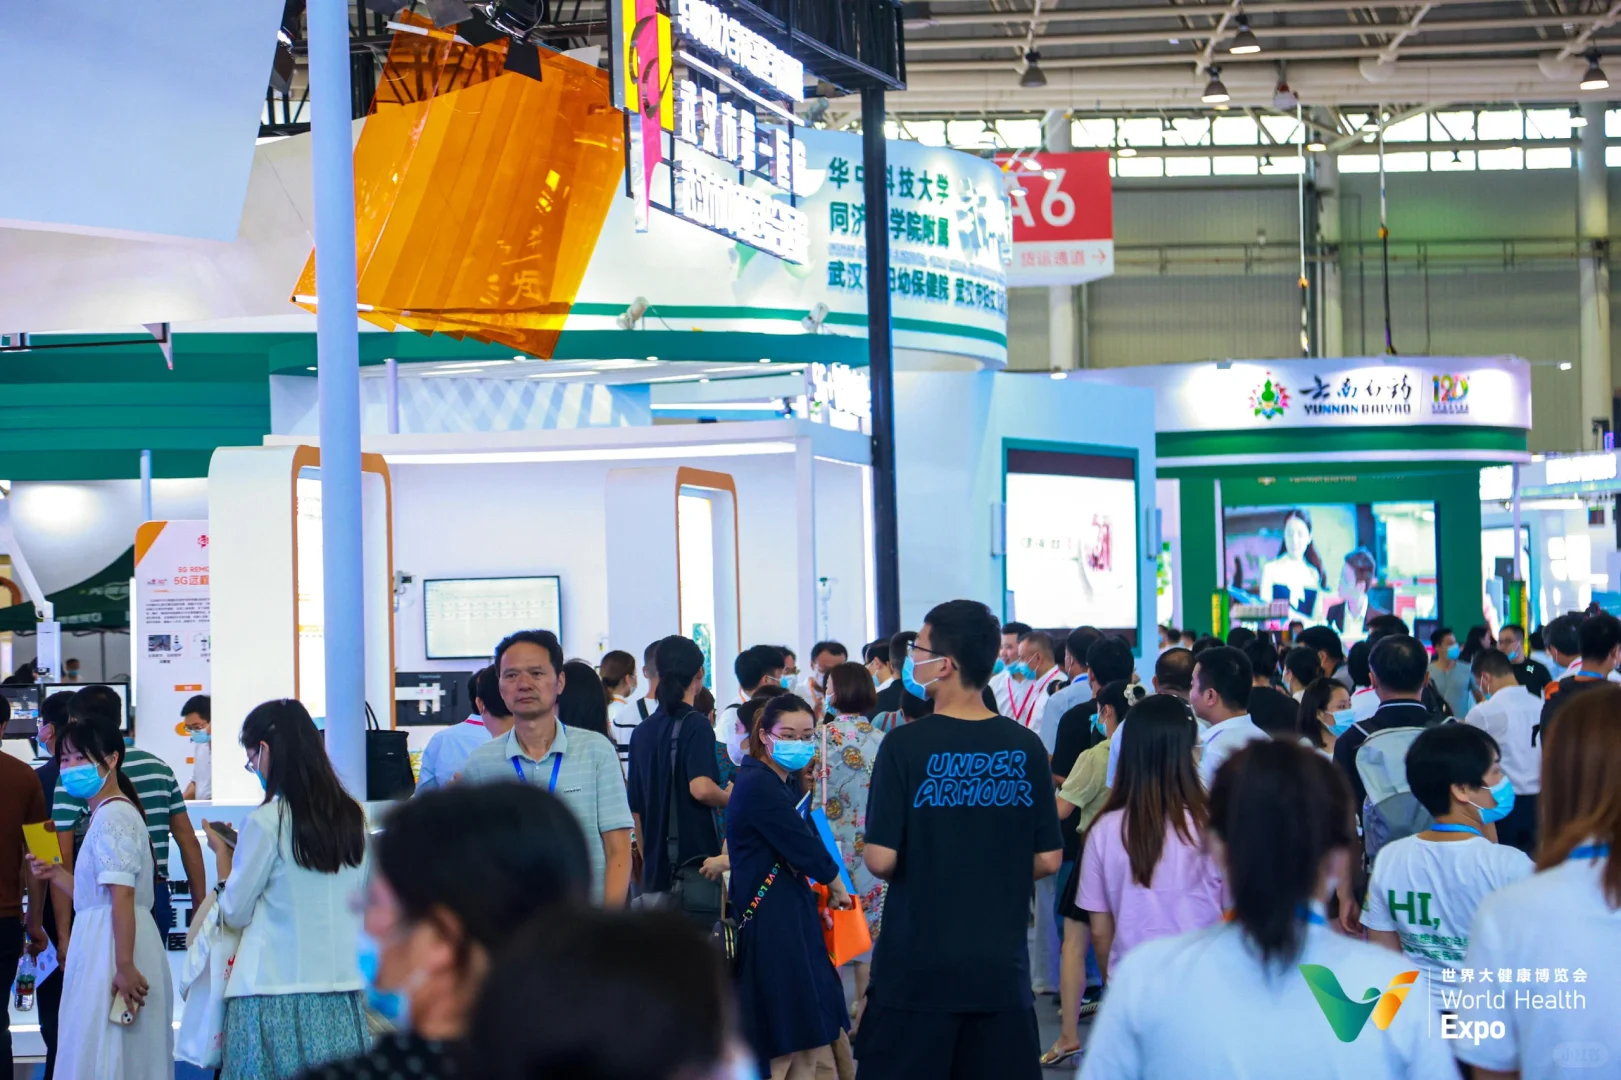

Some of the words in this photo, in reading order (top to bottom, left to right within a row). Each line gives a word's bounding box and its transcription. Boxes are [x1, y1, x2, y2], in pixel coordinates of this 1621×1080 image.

[1003, 168, 1075, 227] A6
[829, 201, 949, 247] 同济学院附属
[828, 260, 949, 300] 武汉幼保健院
[1304, 404, 1359, 416] YUNNAN
[926, 751, 1026, 778] UNDER
[913, 778, 1033, 808] ARMOUR
[750, 885, 768, 909] LOVE
[1388, 890, 1441, 931] HI,
